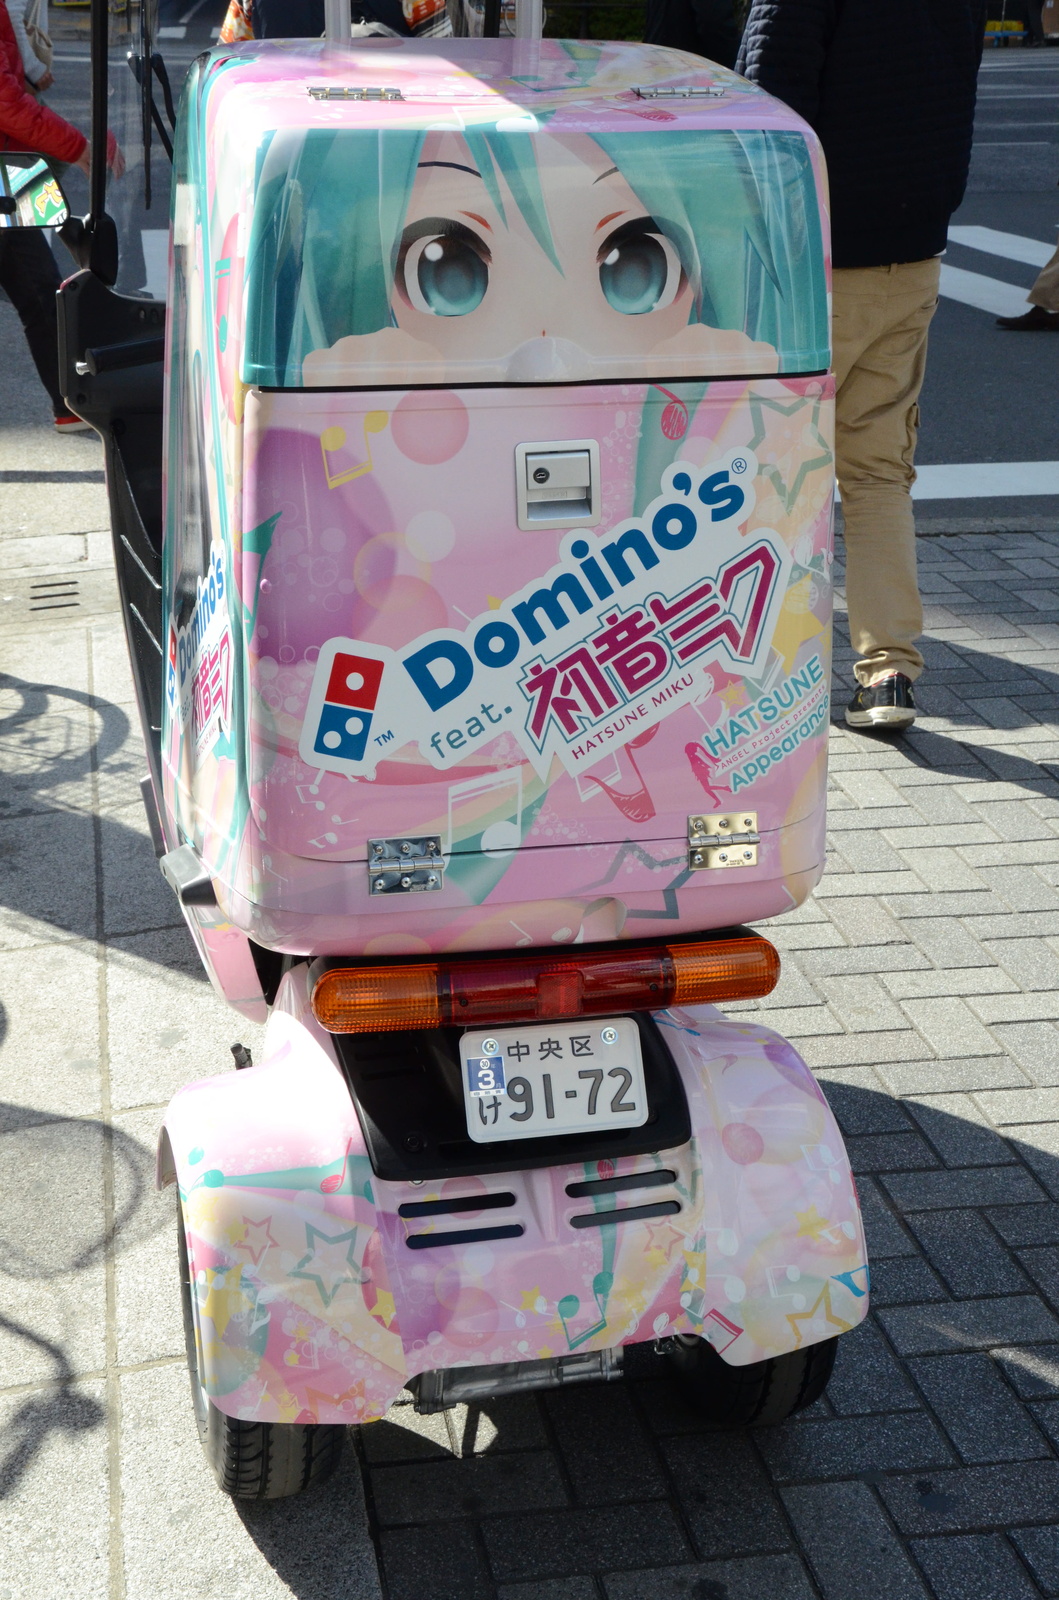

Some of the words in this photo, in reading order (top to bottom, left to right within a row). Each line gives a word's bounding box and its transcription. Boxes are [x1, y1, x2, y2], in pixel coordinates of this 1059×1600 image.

[523, 545, 777, 741] 初音ミク
[374, 729, 395, 748] TM
[430, 704, 513, 760] feat.
[571, 704, 649, 761] HATSUNE
[651, 673, 694, 706] MIKU
[704, 655, 824, 756] HATSUNE
[721, 748, 750, 770] ANGEL
[752, 719, 791, 750] Project
[793, 685, 827, 725] presents
[732, 694, 829, 792] Appearance
[478, 1069, 495, 1089] 3
[507, 1035, 594, 1062] 中央区
[479, 1095, 502, 1125] け
[507, 1067, 636, 1121] 91-72
